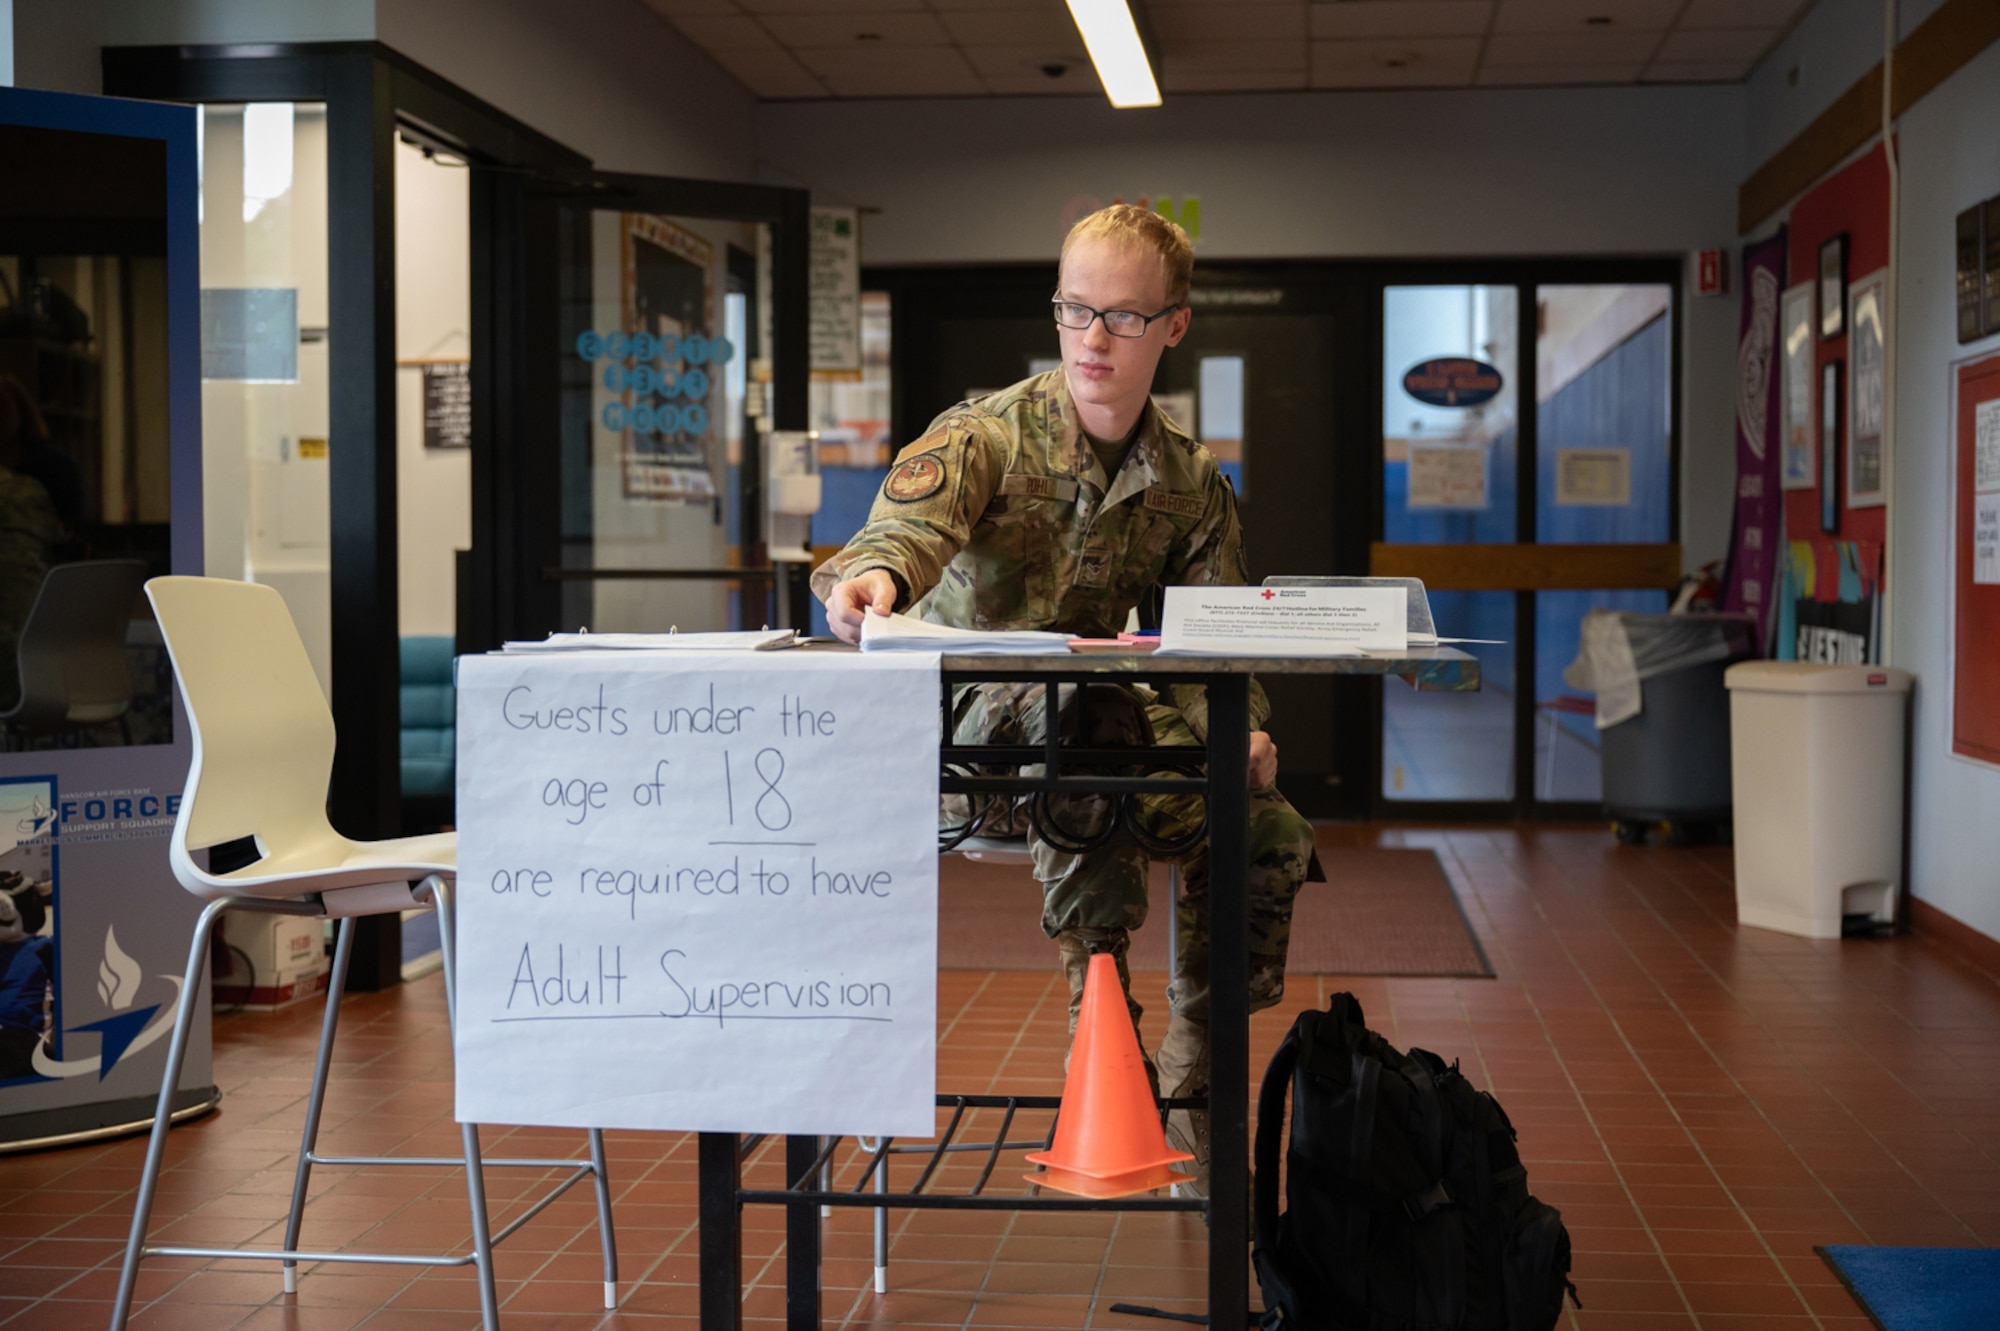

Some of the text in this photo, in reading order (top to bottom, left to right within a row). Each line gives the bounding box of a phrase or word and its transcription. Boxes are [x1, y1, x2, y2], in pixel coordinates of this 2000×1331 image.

[1167, 495, 1203, 516] FORCE
[503, 682, 836, 737] Guests under the
[60, 787, 151, 799] HANSCOM AIR FORCE BASE
[61, 795, 183, 823] FORCE
[542, 747, 793, 831] age of 18
[61, 817, 175, 834] SUPPORT SQUADRO
[491, 855, 893, 921] are required to have
[506, 942, 892, 1029] Adult Supervision
